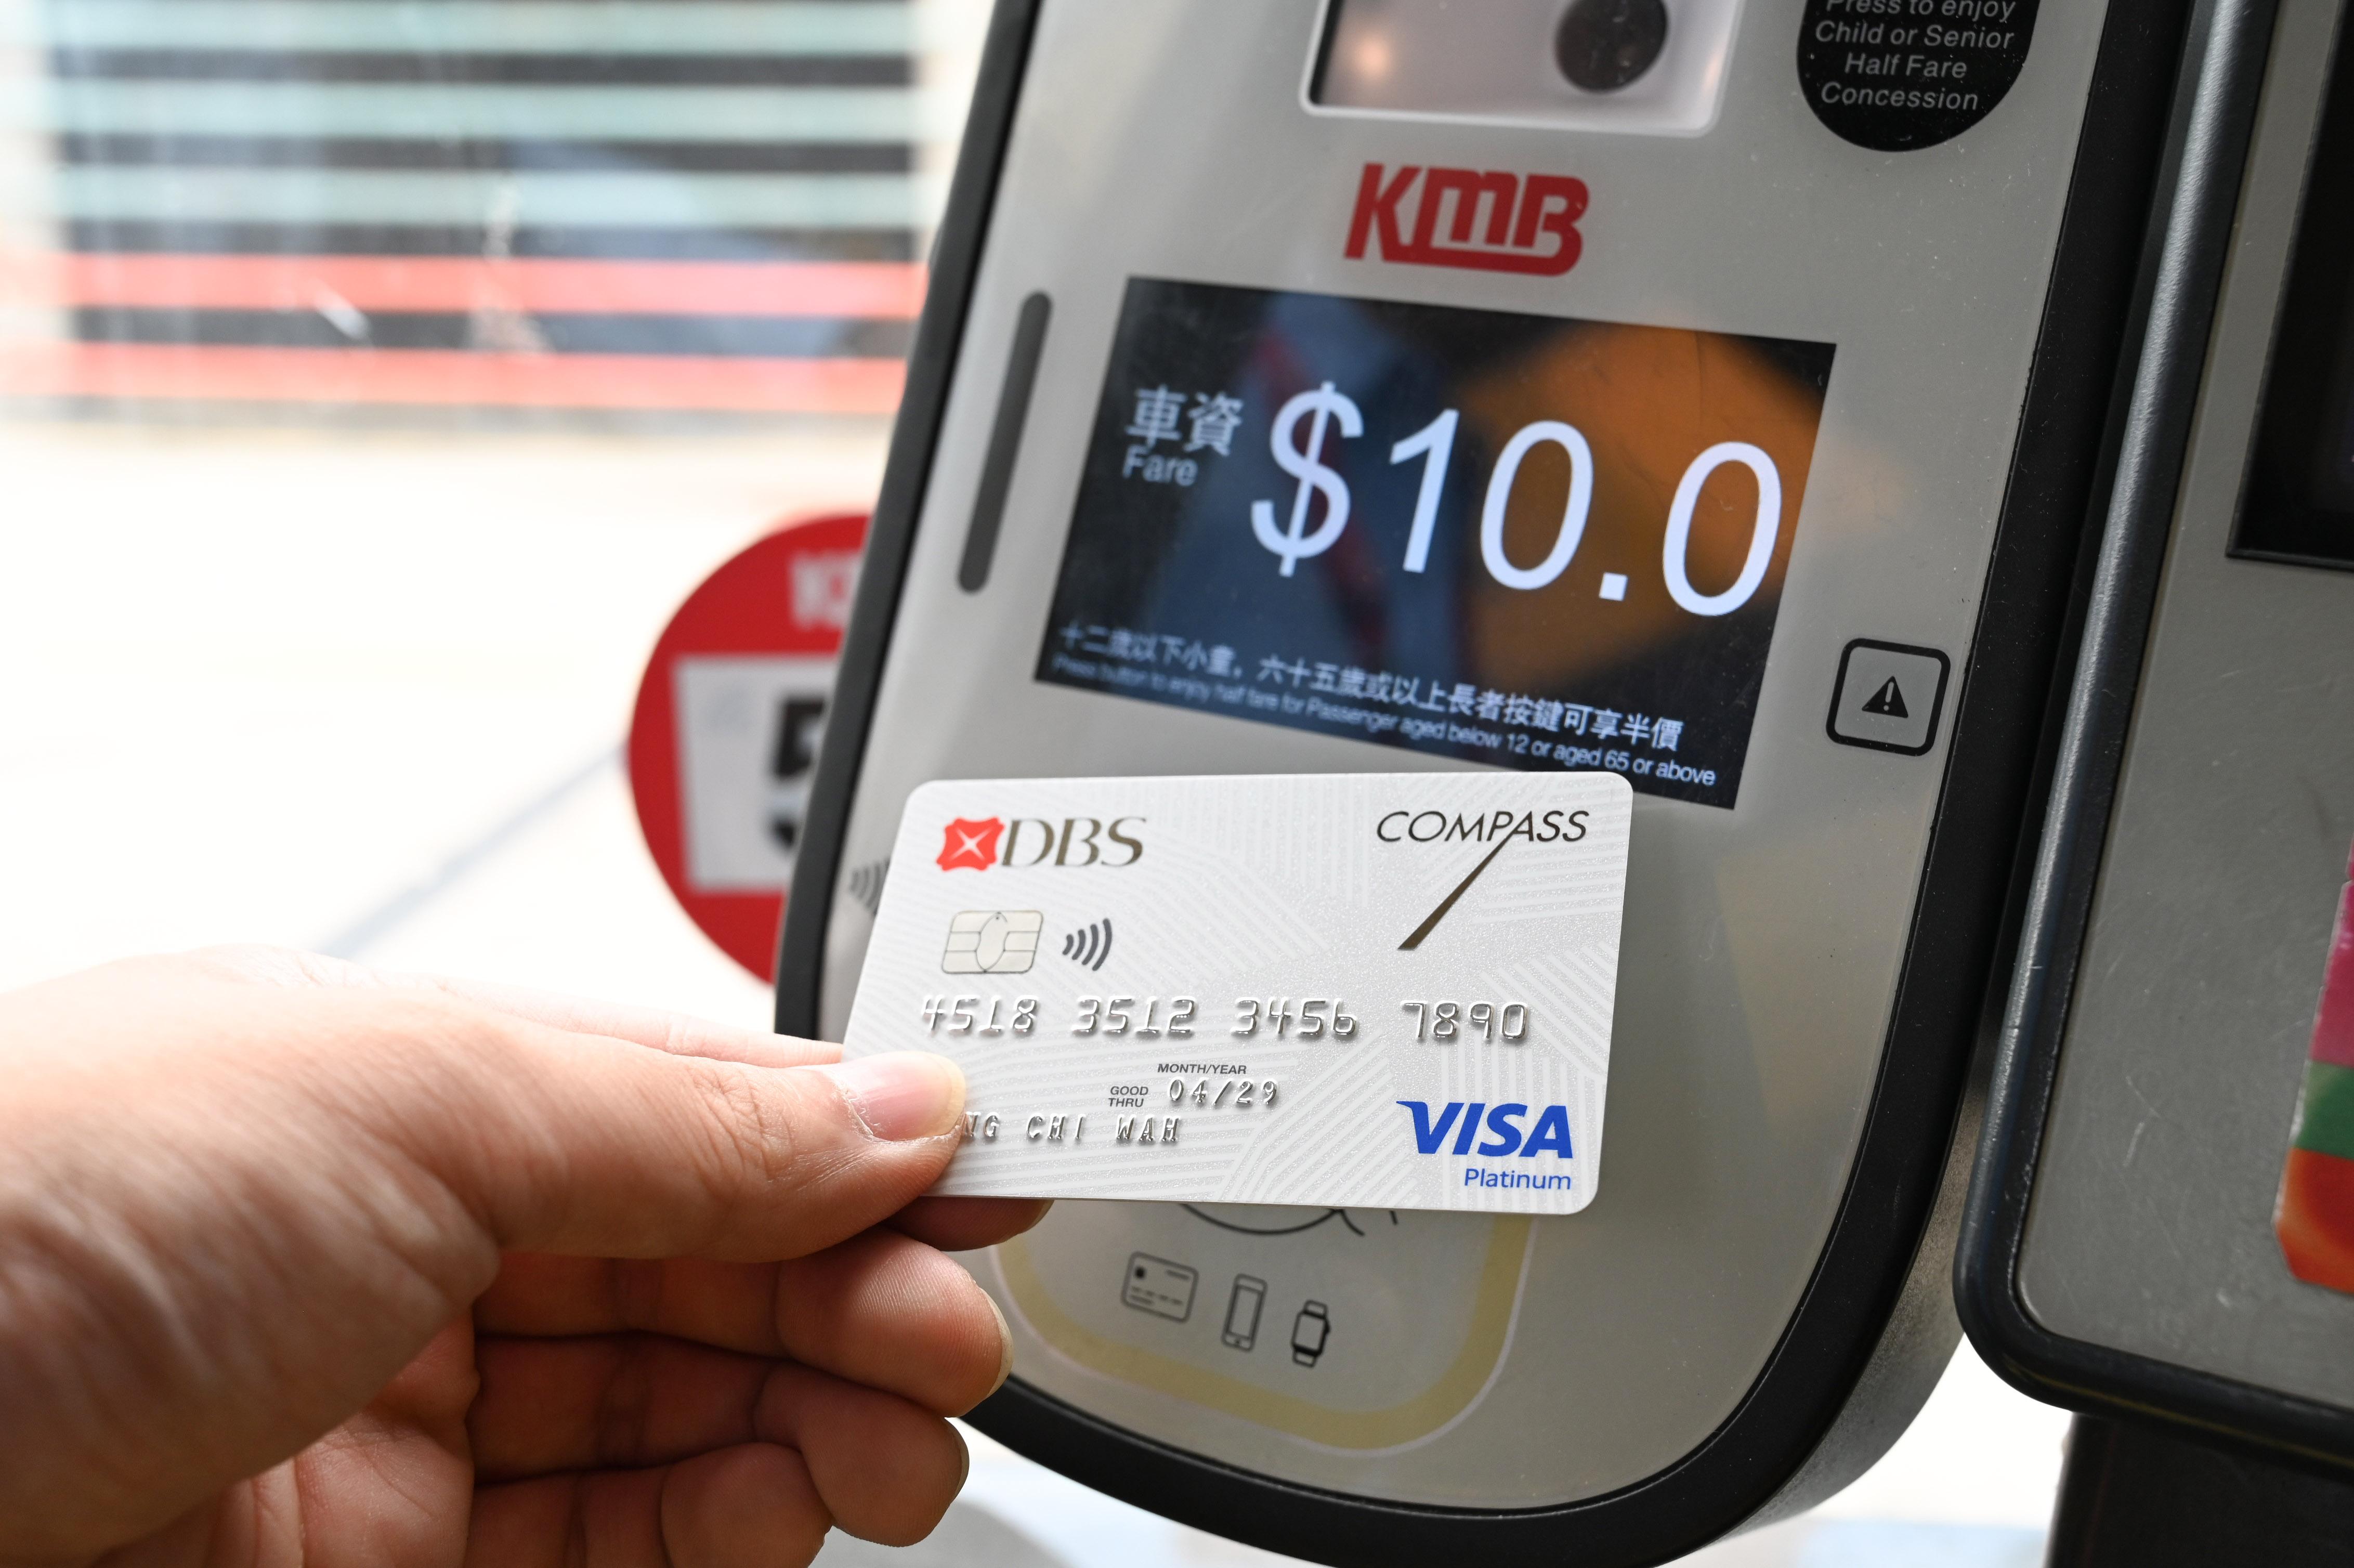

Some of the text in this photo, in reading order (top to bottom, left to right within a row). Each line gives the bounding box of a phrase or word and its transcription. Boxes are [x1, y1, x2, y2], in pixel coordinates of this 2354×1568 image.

[1909, 0, 1933, 15] to
[1941, 0, 2016, 22] enjoy
[1815, 20, 2015, 49] Child or Senior
[1844, 52, 1967, 79] Half Fare
[1821, 81, 1979, 110] Concession
[1343, 162, 1589, 277] KMB
[1124, 383, 1244, 456] 車資
[1122, 443, 1198, 487] Fare
[1250, 381, 1782, 617] $10.0
[1281, 691, 1305, 715] for
[1305, 696, 1399, 733] Passenger
[1400, 716, 1448, 740] aged
[1447, 723, 1502, 749] below
[1507, 734, 1531, 755] 12
[1531, 740, 1553, 757] or
[1553, 743, 1603, 768] aged
[1604, 749, 1631, 772] 65
[1632, 758, 1655, 775] or
[1655, 759, 1716, 786] above
[1377, 810, 1590, 842] COMPASS
[1001, 817, 1147, 867] DBS
[921, 995, 1528, 1039] 4518 3512 3456 7890
[1157, 1064, 1247, 1074] MONTH/YEAR
[1108, 1098, 1144, 1107] THRU
[1110, 1086, 1148, 1095] GOOD
[1167, 1077, 1279, 1106] 04/29
[1026, 1113, 1086, 1140] CHI
[1115, 1114, 1181, 1142] WAH
[1396, 1101, 1573, 1158] VISA
[1464, 1168, 1572, 1190] Platinum
